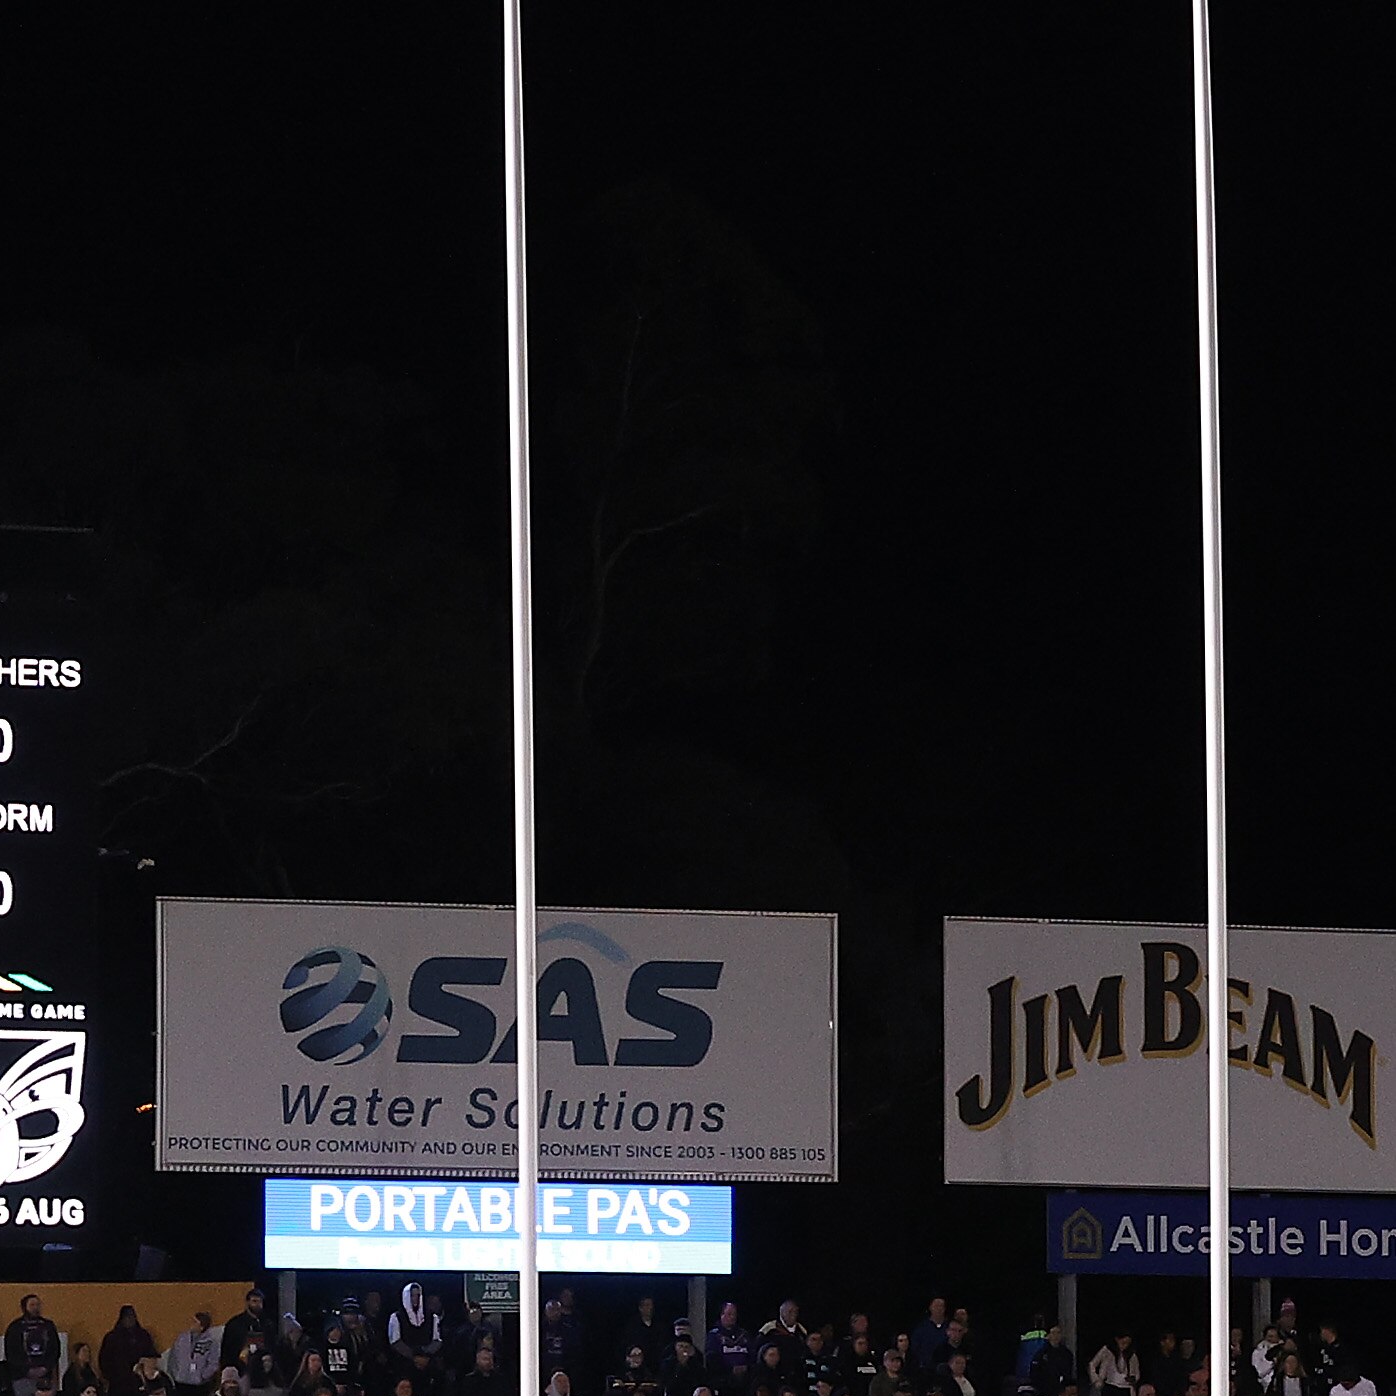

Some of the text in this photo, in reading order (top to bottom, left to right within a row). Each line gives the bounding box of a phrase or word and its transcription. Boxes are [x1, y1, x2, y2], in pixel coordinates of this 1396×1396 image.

[30, 1004, 86, 1021] GAME
[397, 956, 725, 1067] SAS
[955, 974, 1126, 1130] JIM
[280, 1084, 442, 1129] Water
[168, 1137, 271, 1152] PROTECTING
[276, 1138, 311, 1152] OUR
[316, 1140, 417, 1154] COMMUNITY
[421, 1142, 458, 1155] AND
[462, 1143, 497, 1157] OUR
[502, 1143, 621, 1159] ENRONMENT
[626, 1145, 672, 1159] SINCE
[677, 1146, 715, 1160] 2003
[730, 1147, 765, 1161] 1300
[770, 1147, 797, 1161] 885
[801, 1148, 826, 1162] 105
[16, 1198, 85, 1227] AUG
[587, 1187, 692, 1238] PA'S
[482, 1291, 513, 1300] AREA
